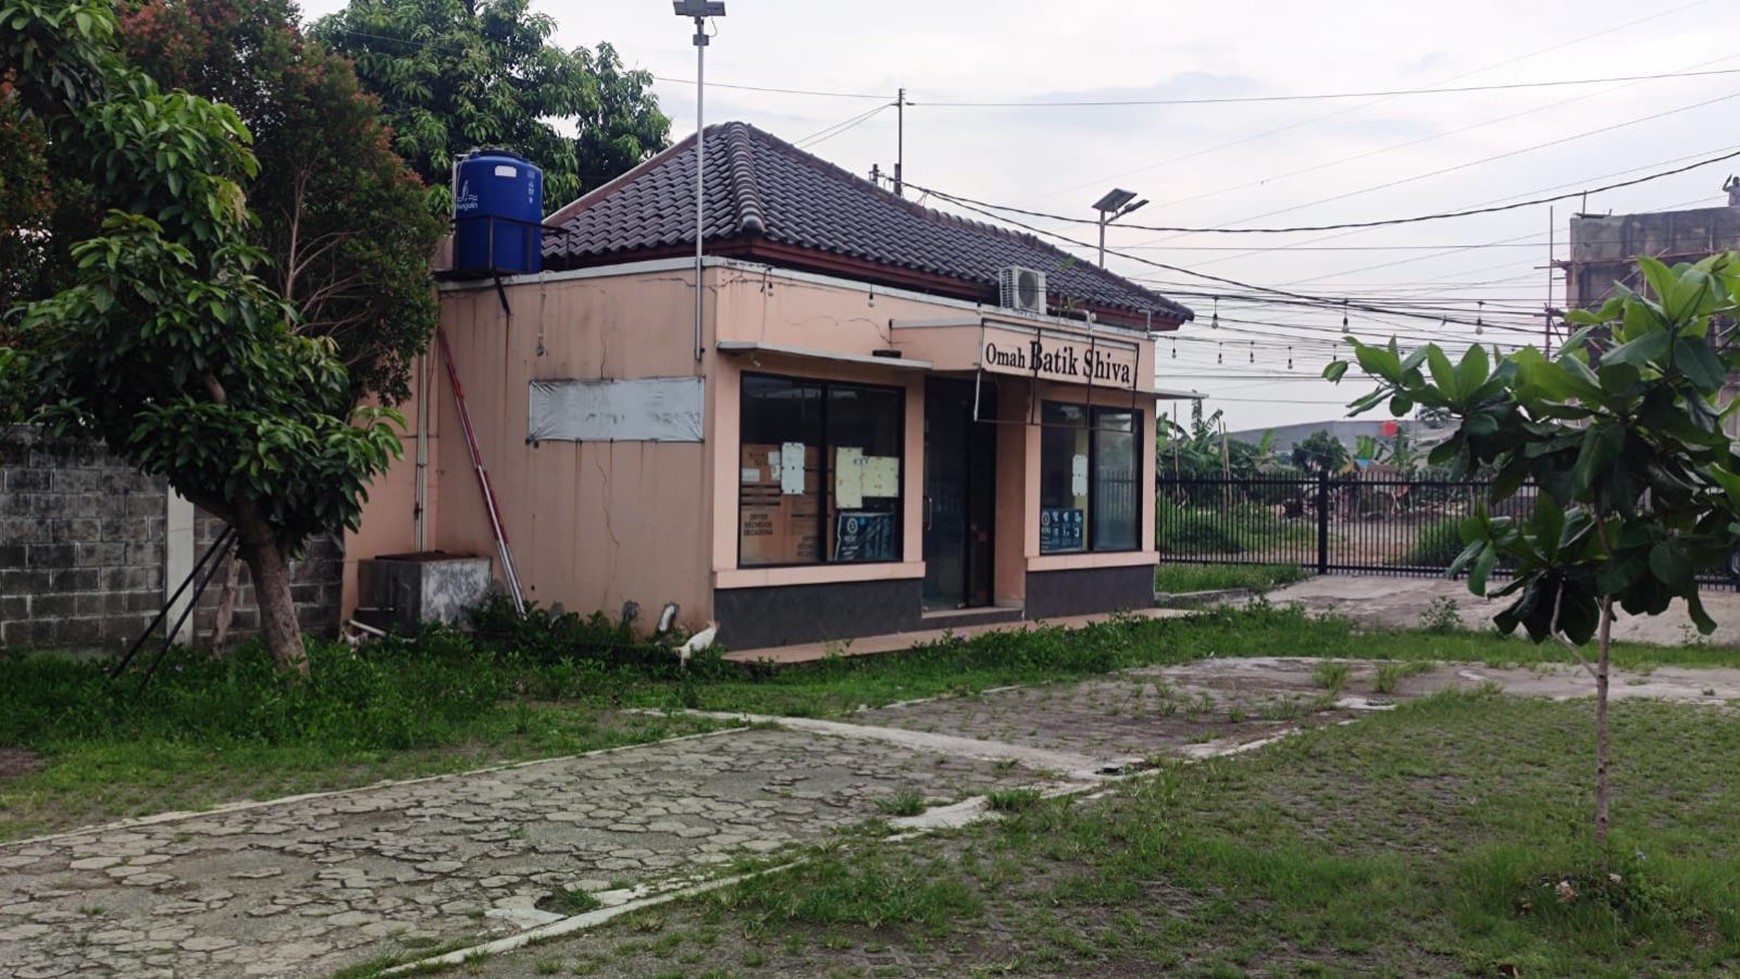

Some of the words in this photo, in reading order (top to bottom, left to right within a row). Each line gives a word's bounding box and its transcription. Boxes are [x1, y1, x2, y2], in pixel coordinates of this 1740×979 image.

[985, 342, 1026, 368] Omah
[1029, 340, 1079, 376] Batik
[1083, 349, 1130, 384] Shiva
